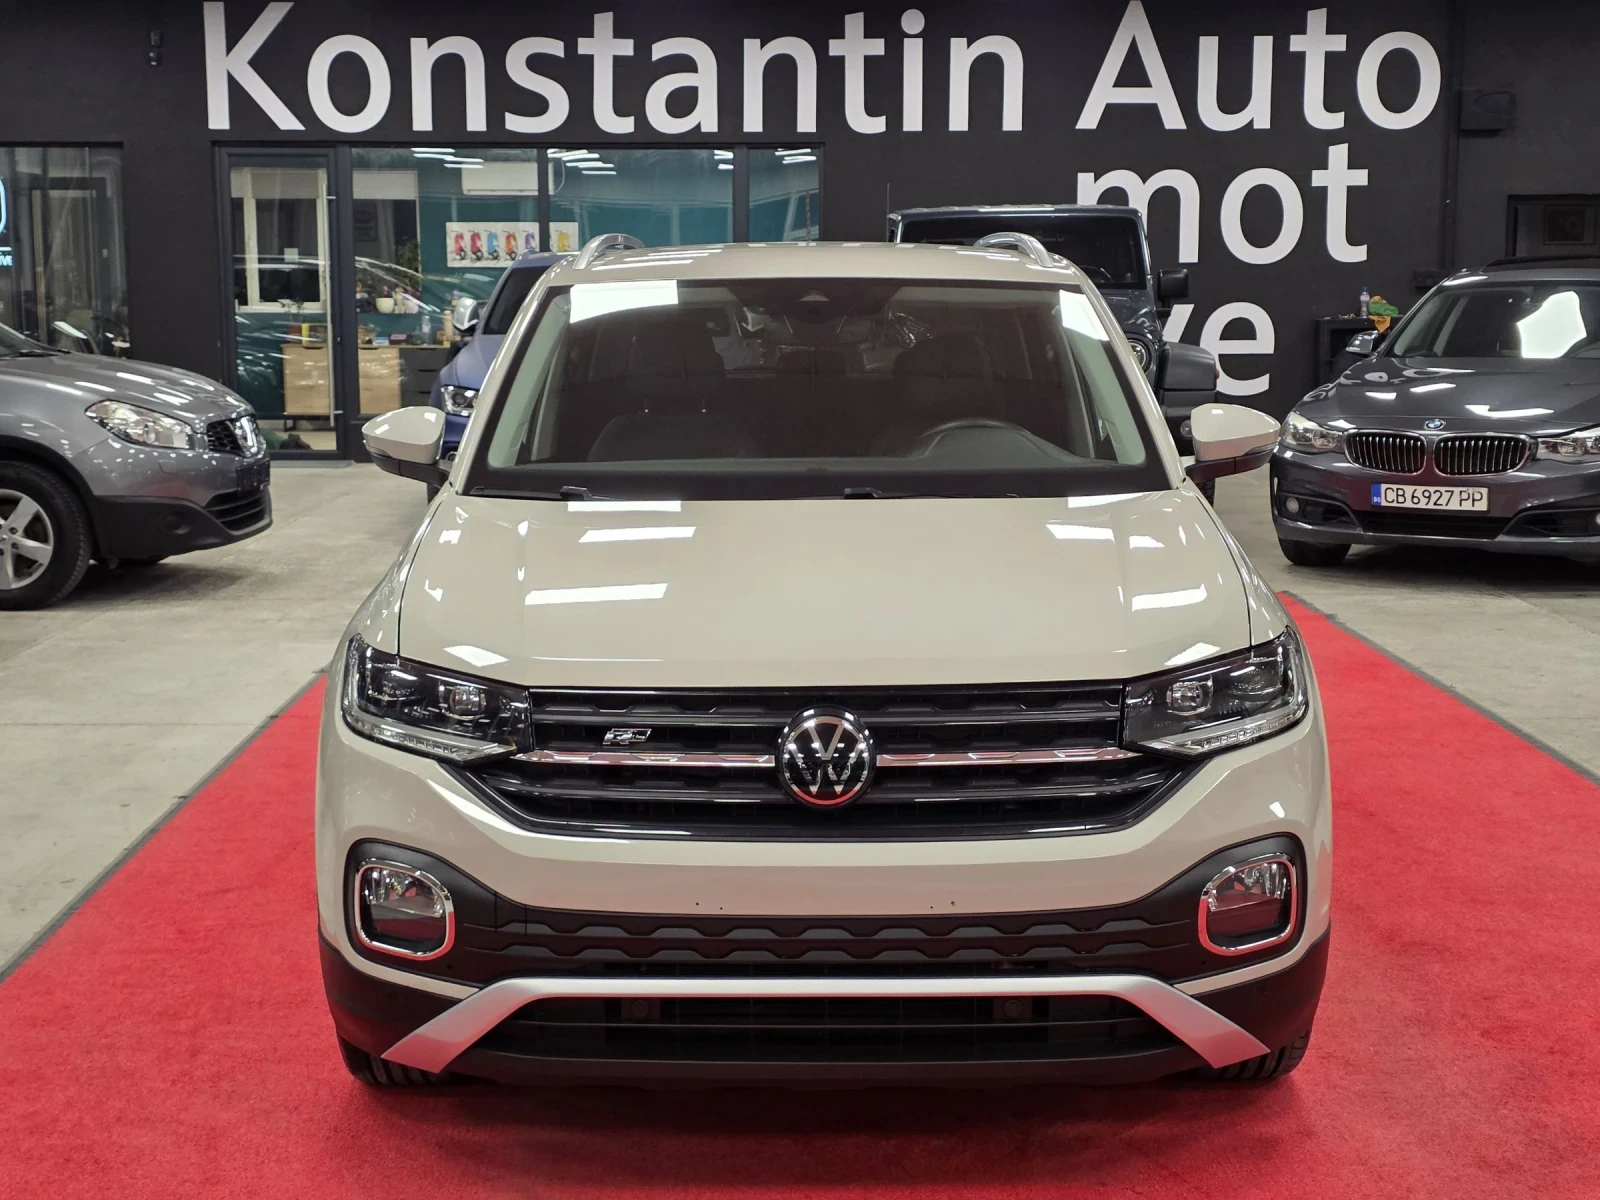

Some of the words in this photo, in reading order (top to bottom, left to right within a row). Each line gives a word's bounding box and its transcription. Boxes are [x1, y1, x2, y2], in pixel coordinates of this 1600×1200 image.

[203, 1, 1024, 135] Konstantin
[1075, 0, 1441, 132] Auto
[1076, 142, 1369, 264] mot
[1384, 487, 1407, 504] CB
[1410, 488, 1455, 507] 6927
[1459, 489, 1484, 508] PP
